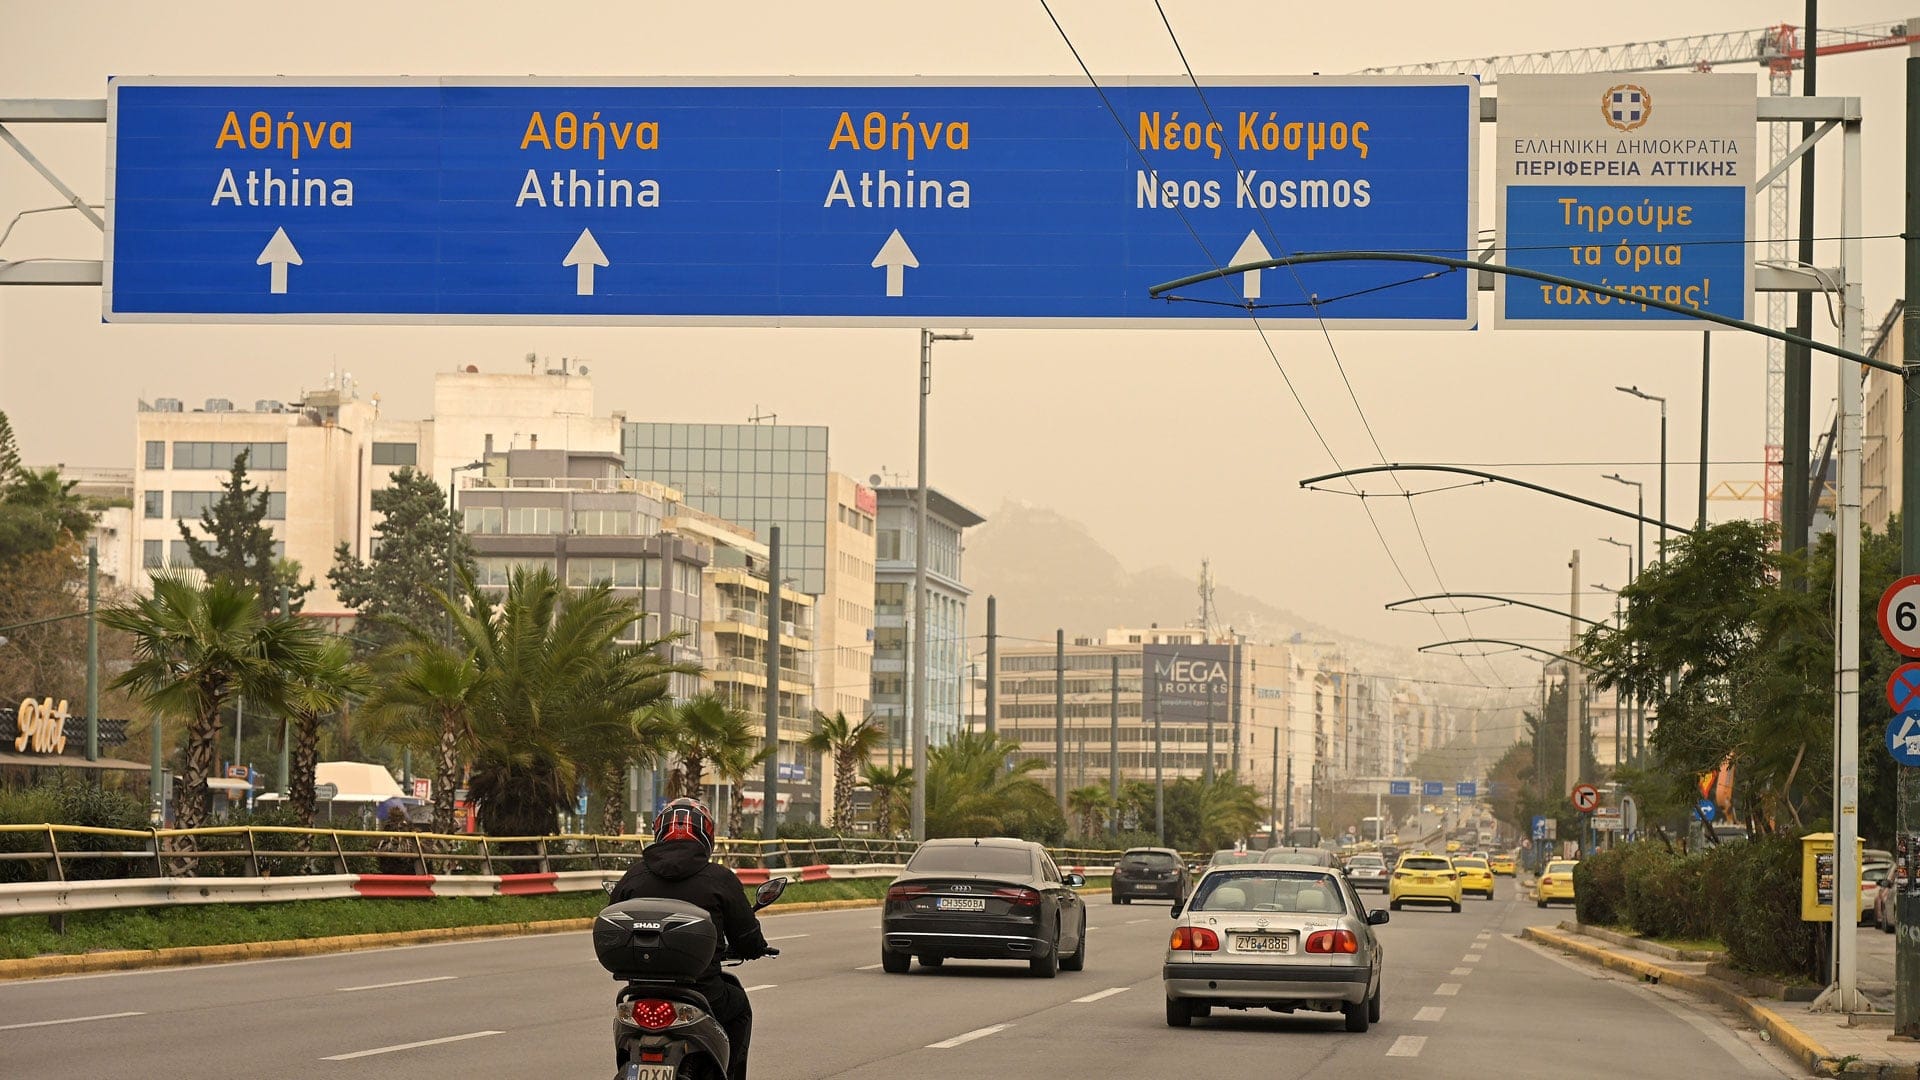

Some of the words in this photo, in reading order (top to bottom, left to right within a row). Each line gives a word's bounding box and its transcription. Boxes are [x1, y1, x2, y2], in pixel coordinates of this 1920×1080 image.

[215, 111, 352, 159] Αθήνα
[521, 111, 659, 159] Αθήνα
[829, 111, 969, 160] Αθήνα
[1139, 111, 1223, 159] Νέος
[1238, 111, 1370, 160] Κόσμος
[1514, 139, 1607, 154] ΕΛΛΗΝΙΚΗ
[1616, 139, 1738, 154] ΔΗΜΟΚΡΑΤΙΑ
[211, 167, 353, 207] Athina
[515, 168, 660, 208] Athina
[1515, 160, 1641, 176] ΠΕΡΙΦΕΡΕΙΑ
[1651, 160, 1737, 176] ΑΤΤΙΚΗΣ
[823, 169, 970, 209] Athina
[1136, 169, 1221, 209] Neos
[1236, 169, 1371, 209] Kosmos
[1558, 198, 1693, 232] Τηρούμε
[1569, 246, 1601, 265] τα
[1614, 238, 1681, 272] όρια
[1540, 278, 1711, 312] ταχύτητας!
[1155, 652, 1228, 682] MEGA
